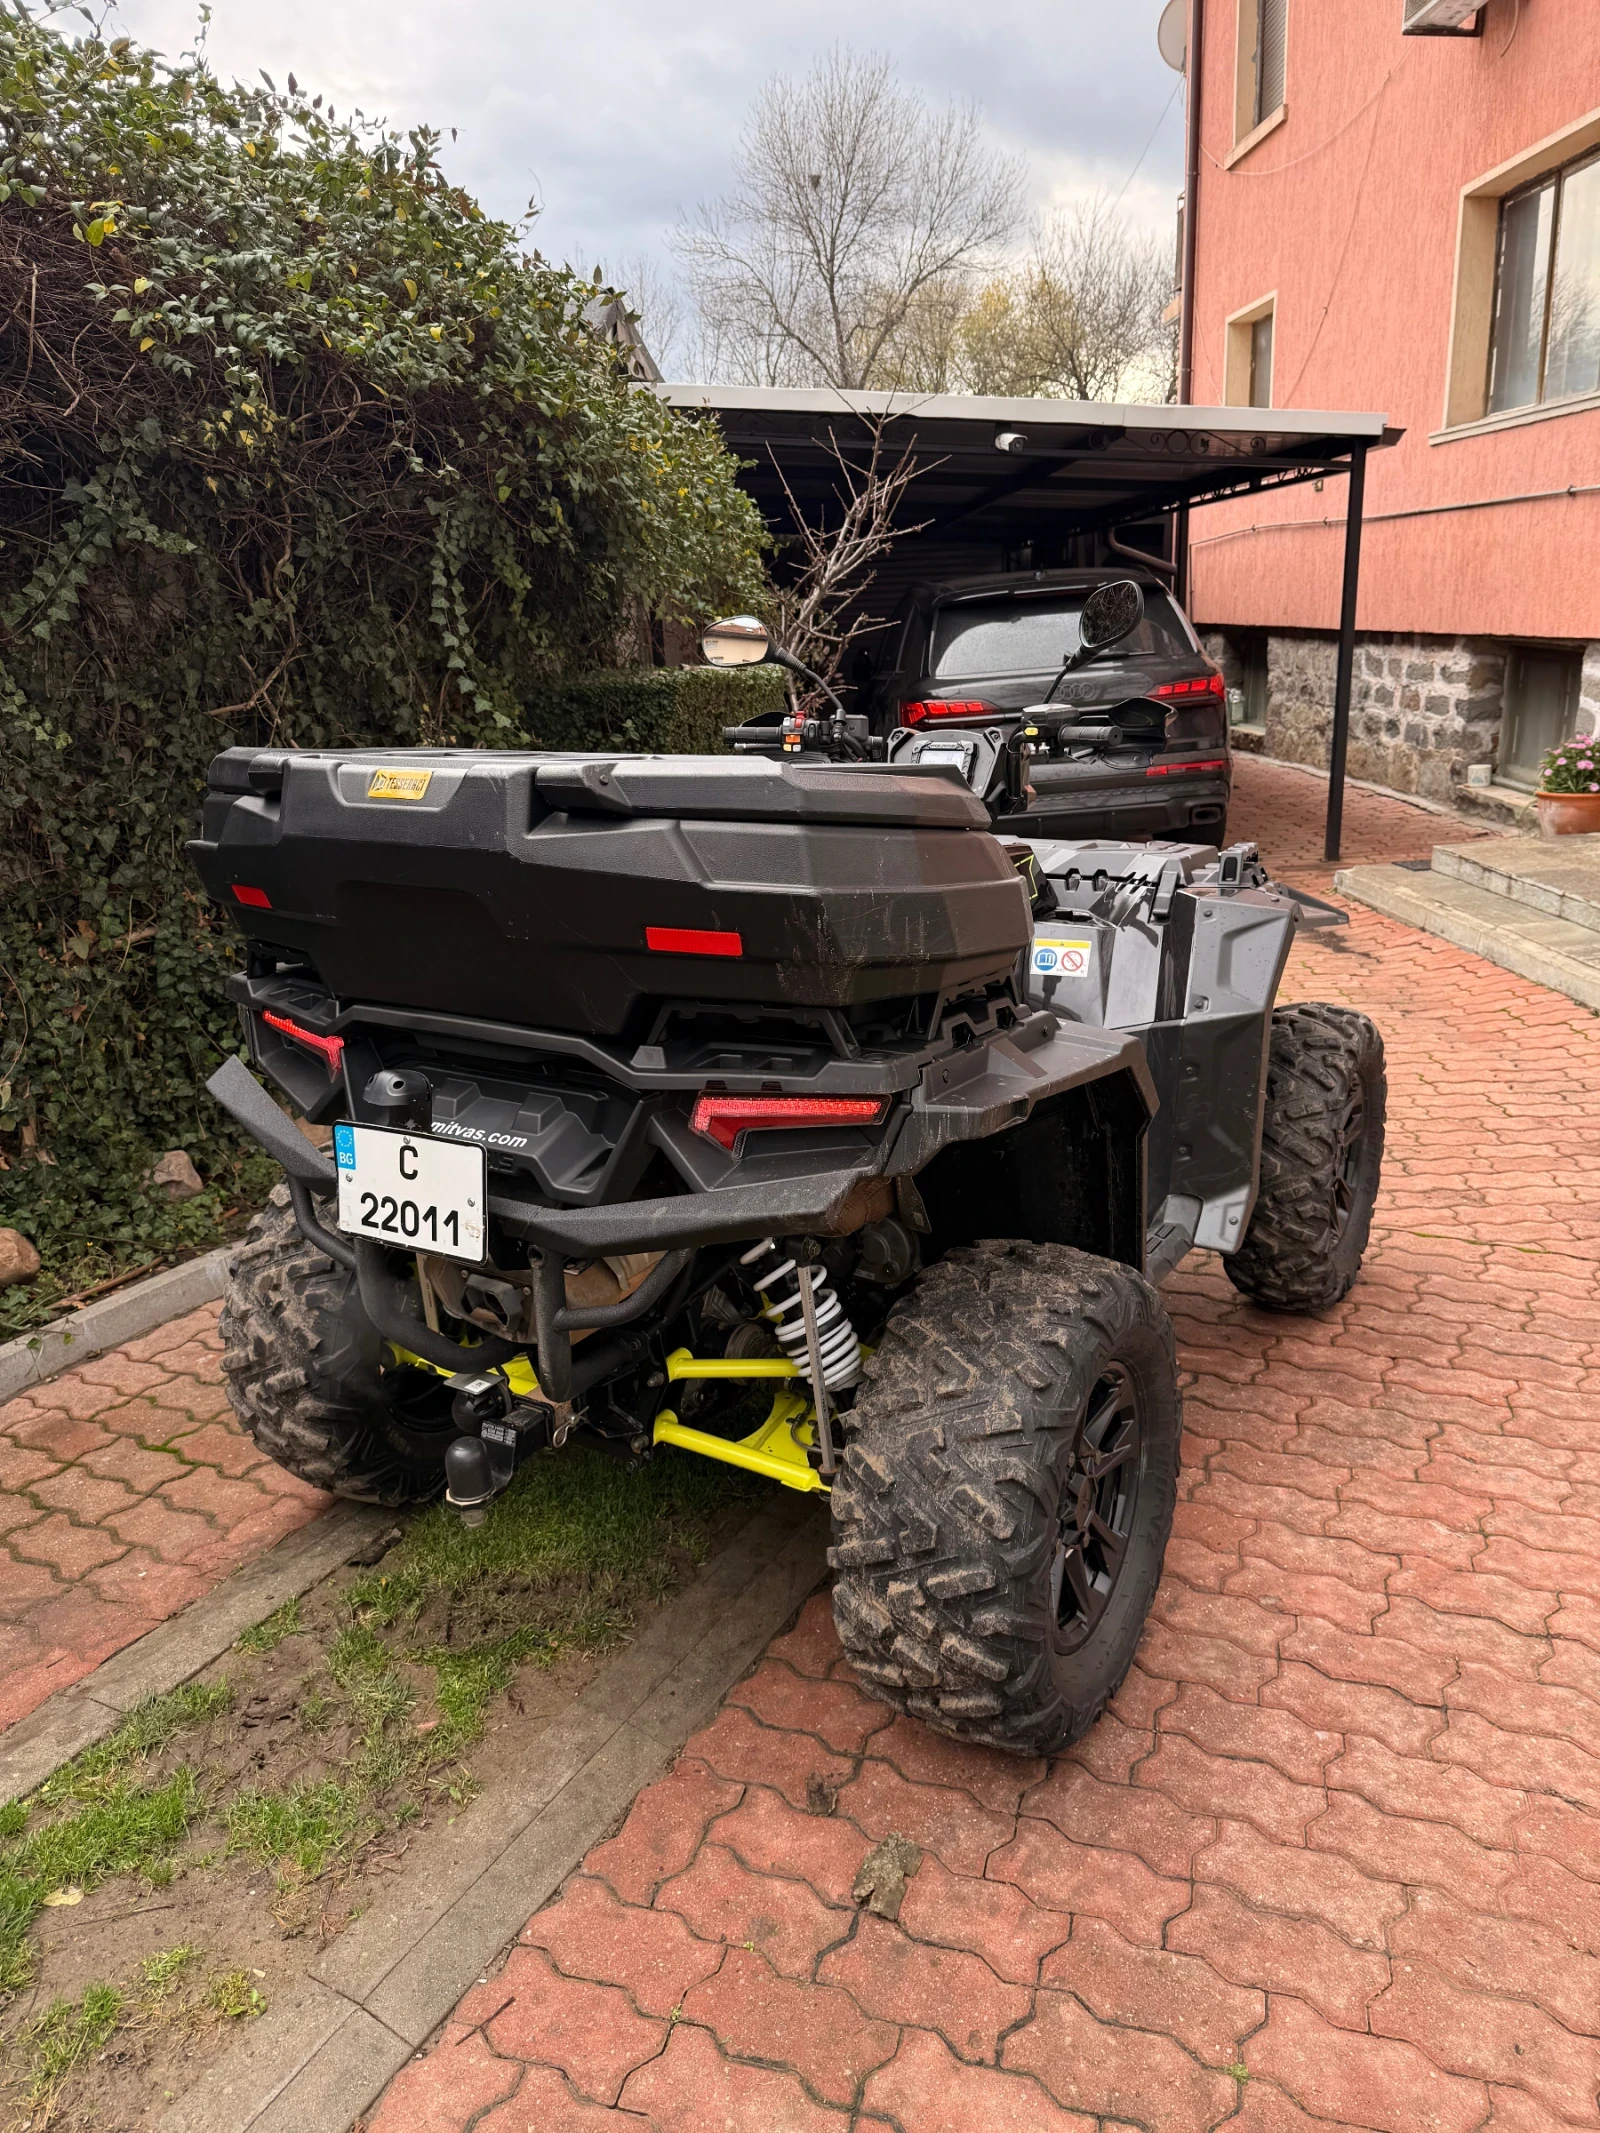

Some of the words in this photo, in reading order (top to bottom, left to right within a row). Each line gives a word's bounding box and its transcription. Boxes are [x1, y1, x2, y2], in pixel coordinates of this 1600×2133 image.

[387, 777, 427, 791] TESSERACT
[430, 1121, 528, 1147] mitvas.com
[339, 1151, 354, 1165] BG
[399, 1145, 419, 1180] C
[360, 1192, 459, 1247] 22011
